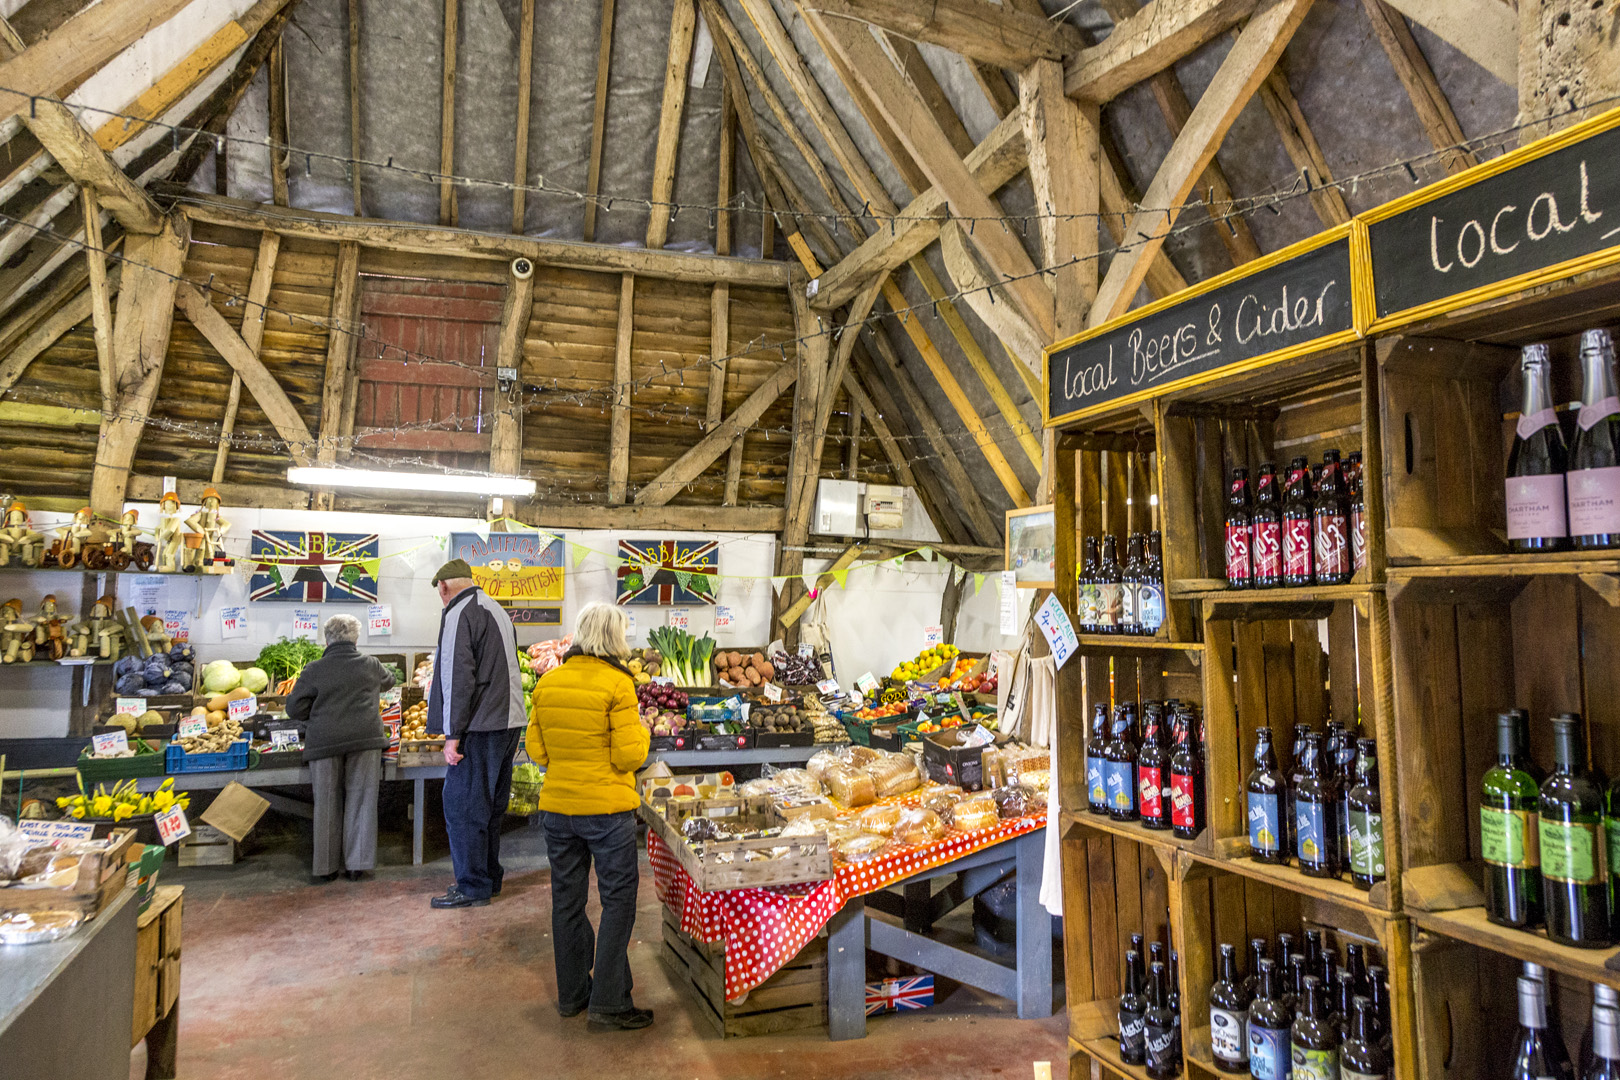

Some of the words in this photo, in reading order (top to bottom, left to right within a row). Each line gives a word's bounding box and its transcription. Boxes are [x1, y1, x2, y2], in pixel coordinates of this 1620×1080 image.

[1128, 326, 1198, 386] Beers
[1205, 303, 1222, 345] &
[1235, 281, 1336, 346] Cider
[628, 545, 709, 571] CABBAGES
[488, 578, 506, 596] OF
[510, 567, 559, 597] BRITISH
[1052, 635, 1067, 660] £10
